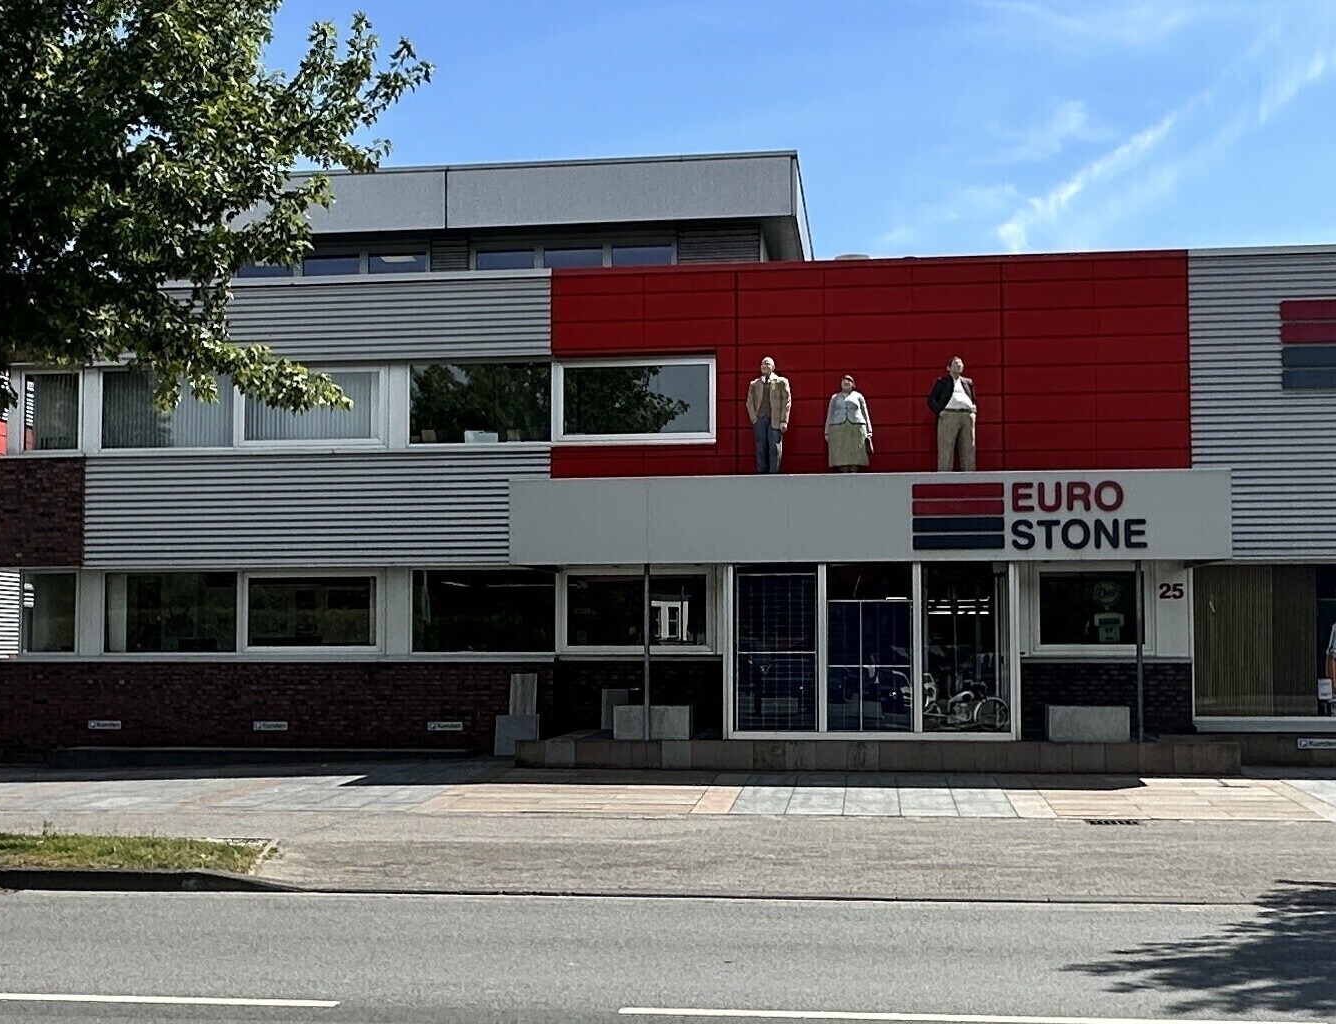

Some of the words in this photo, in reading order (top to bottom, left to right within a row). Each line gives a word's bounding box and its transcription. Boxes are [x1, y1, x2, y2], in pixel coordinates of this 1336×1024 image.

[1011, 480, 1124, 513] EURO
[1011, 518, 1148, 550] STONE
[1159, 583, 1184, 600] 25
